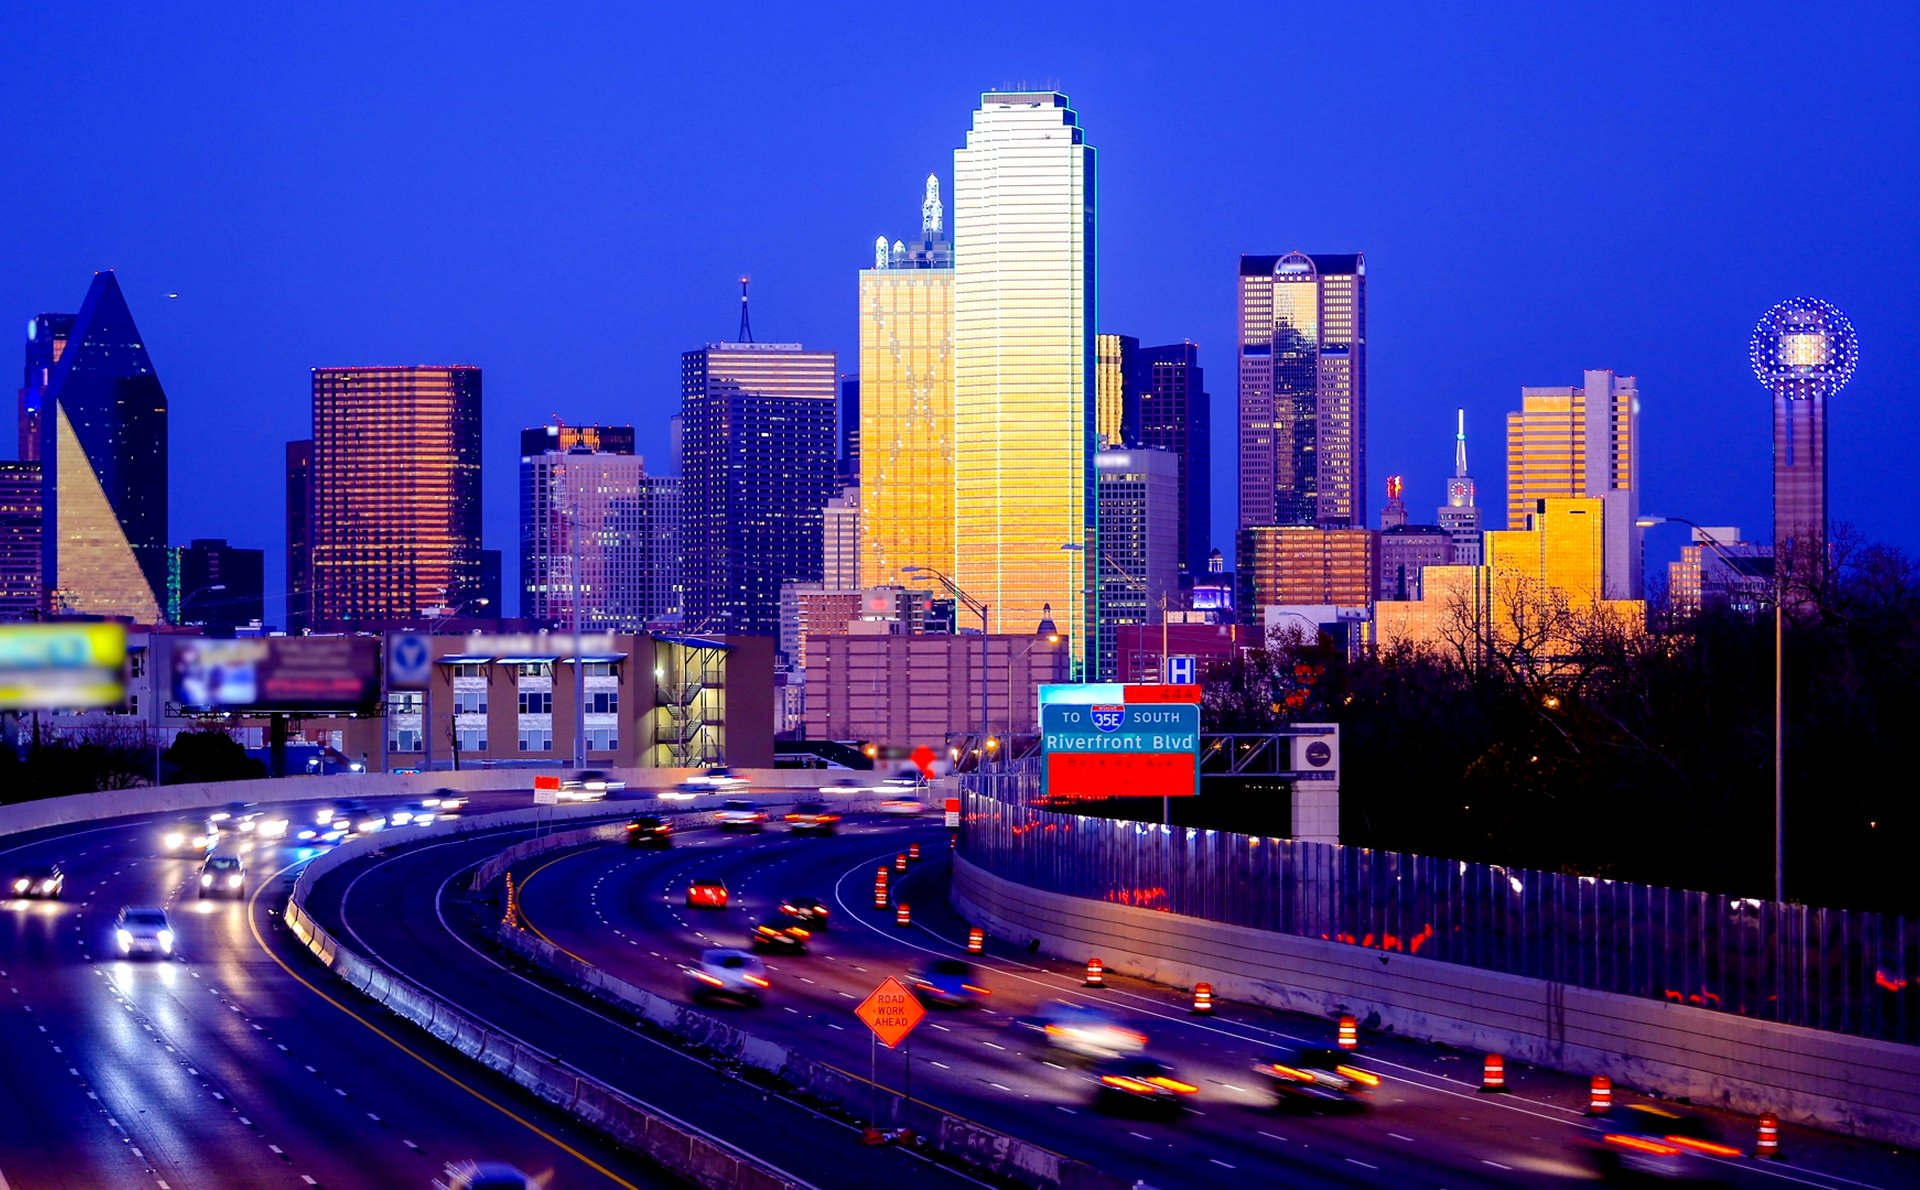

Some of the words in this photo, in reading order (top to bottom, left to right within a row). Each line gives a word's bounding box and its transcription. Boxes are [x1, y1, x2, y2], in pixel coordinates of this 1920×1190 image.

[1171, 659, 1191, 683] H
[1062, 712, 1081, 723] TO
[1095, 713, 1120, 726] 35E
[1133, 712, 1180, 723] SOUTH
[1047, 734, 1142, 749] Riverfront
[1153, 734, 1193, 749] Blvd
[878, 995, 904, 1003] ROAD
[878, 1006, 904, 1015] WORK
[875, 1017, 908, 1027] AHEAD
